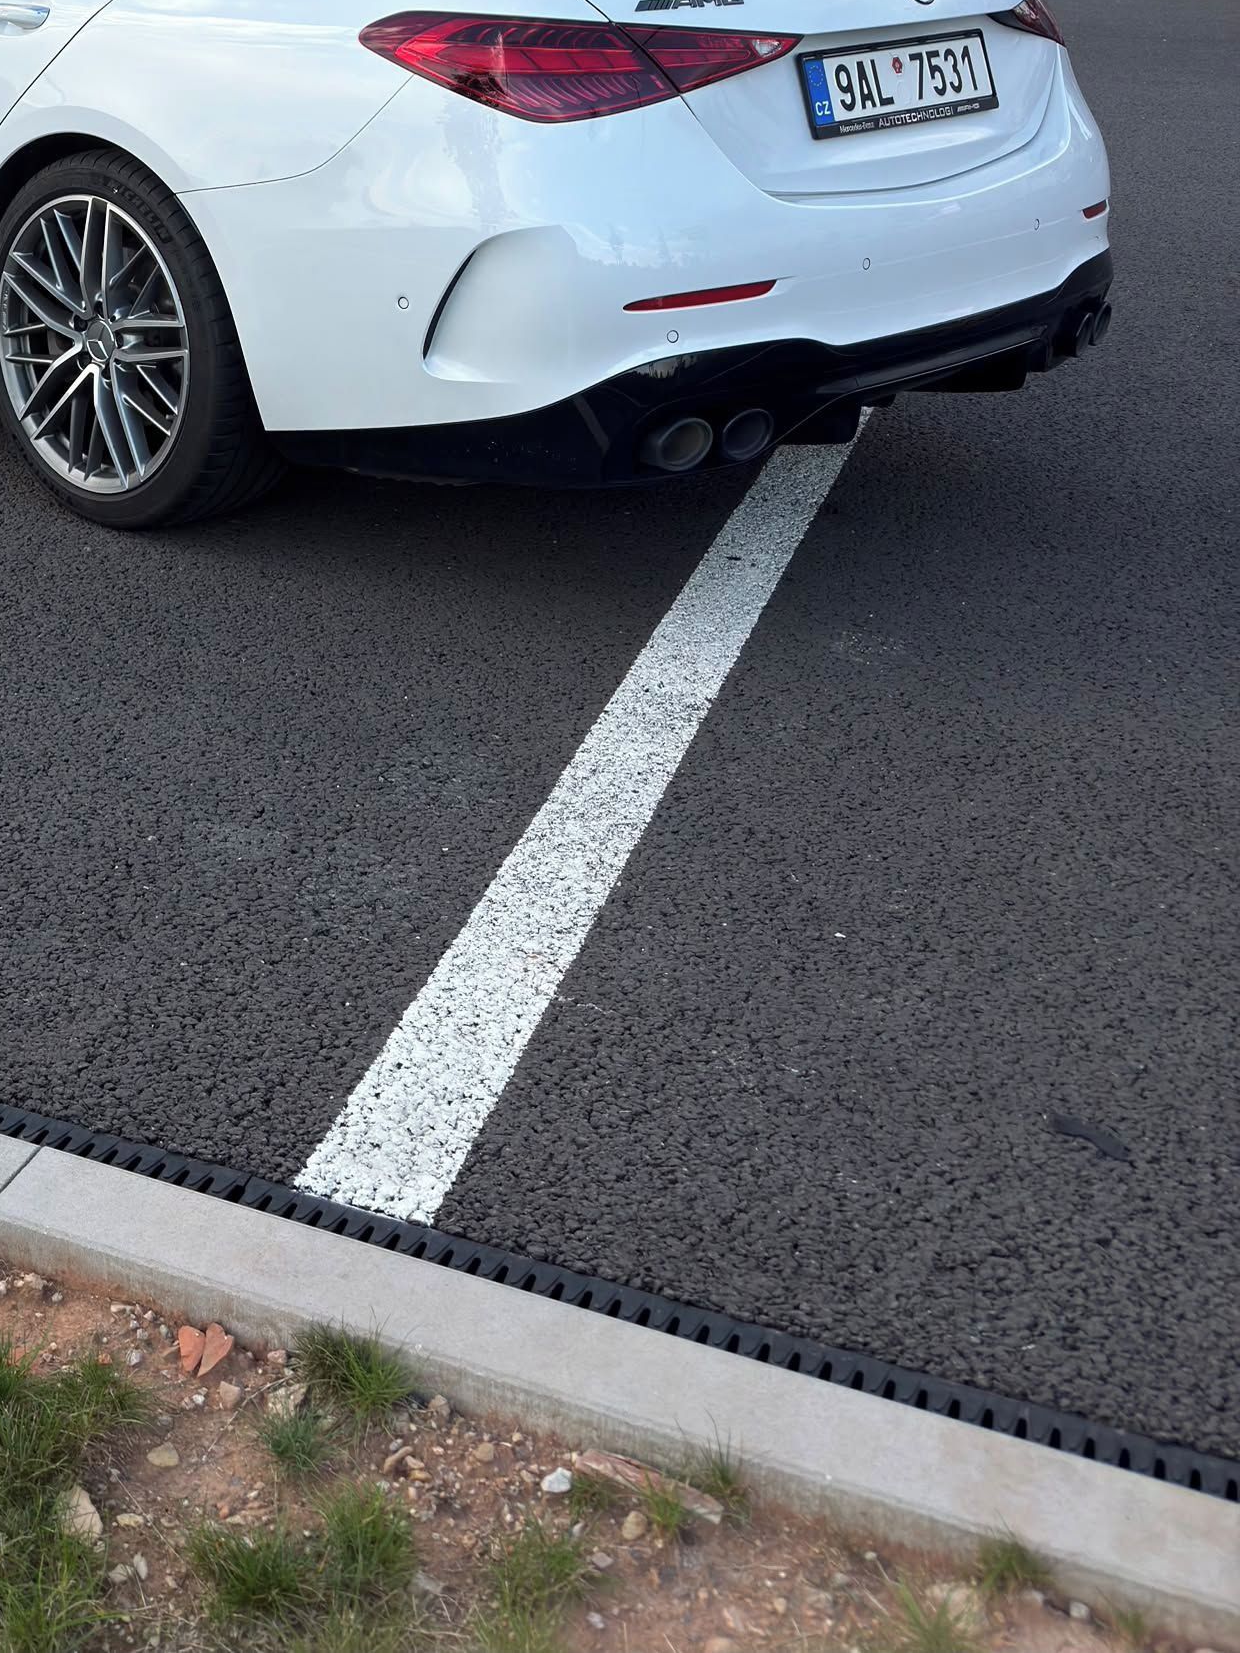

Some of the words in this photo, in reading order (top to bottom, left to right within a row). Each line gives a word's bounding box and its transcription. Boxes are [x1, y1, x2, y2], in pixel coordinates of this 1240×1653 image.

[834, 59, 895, 112] 9AL
[908, 45, 979, 101] 7531
[815, 100, 832, 116] CZ
